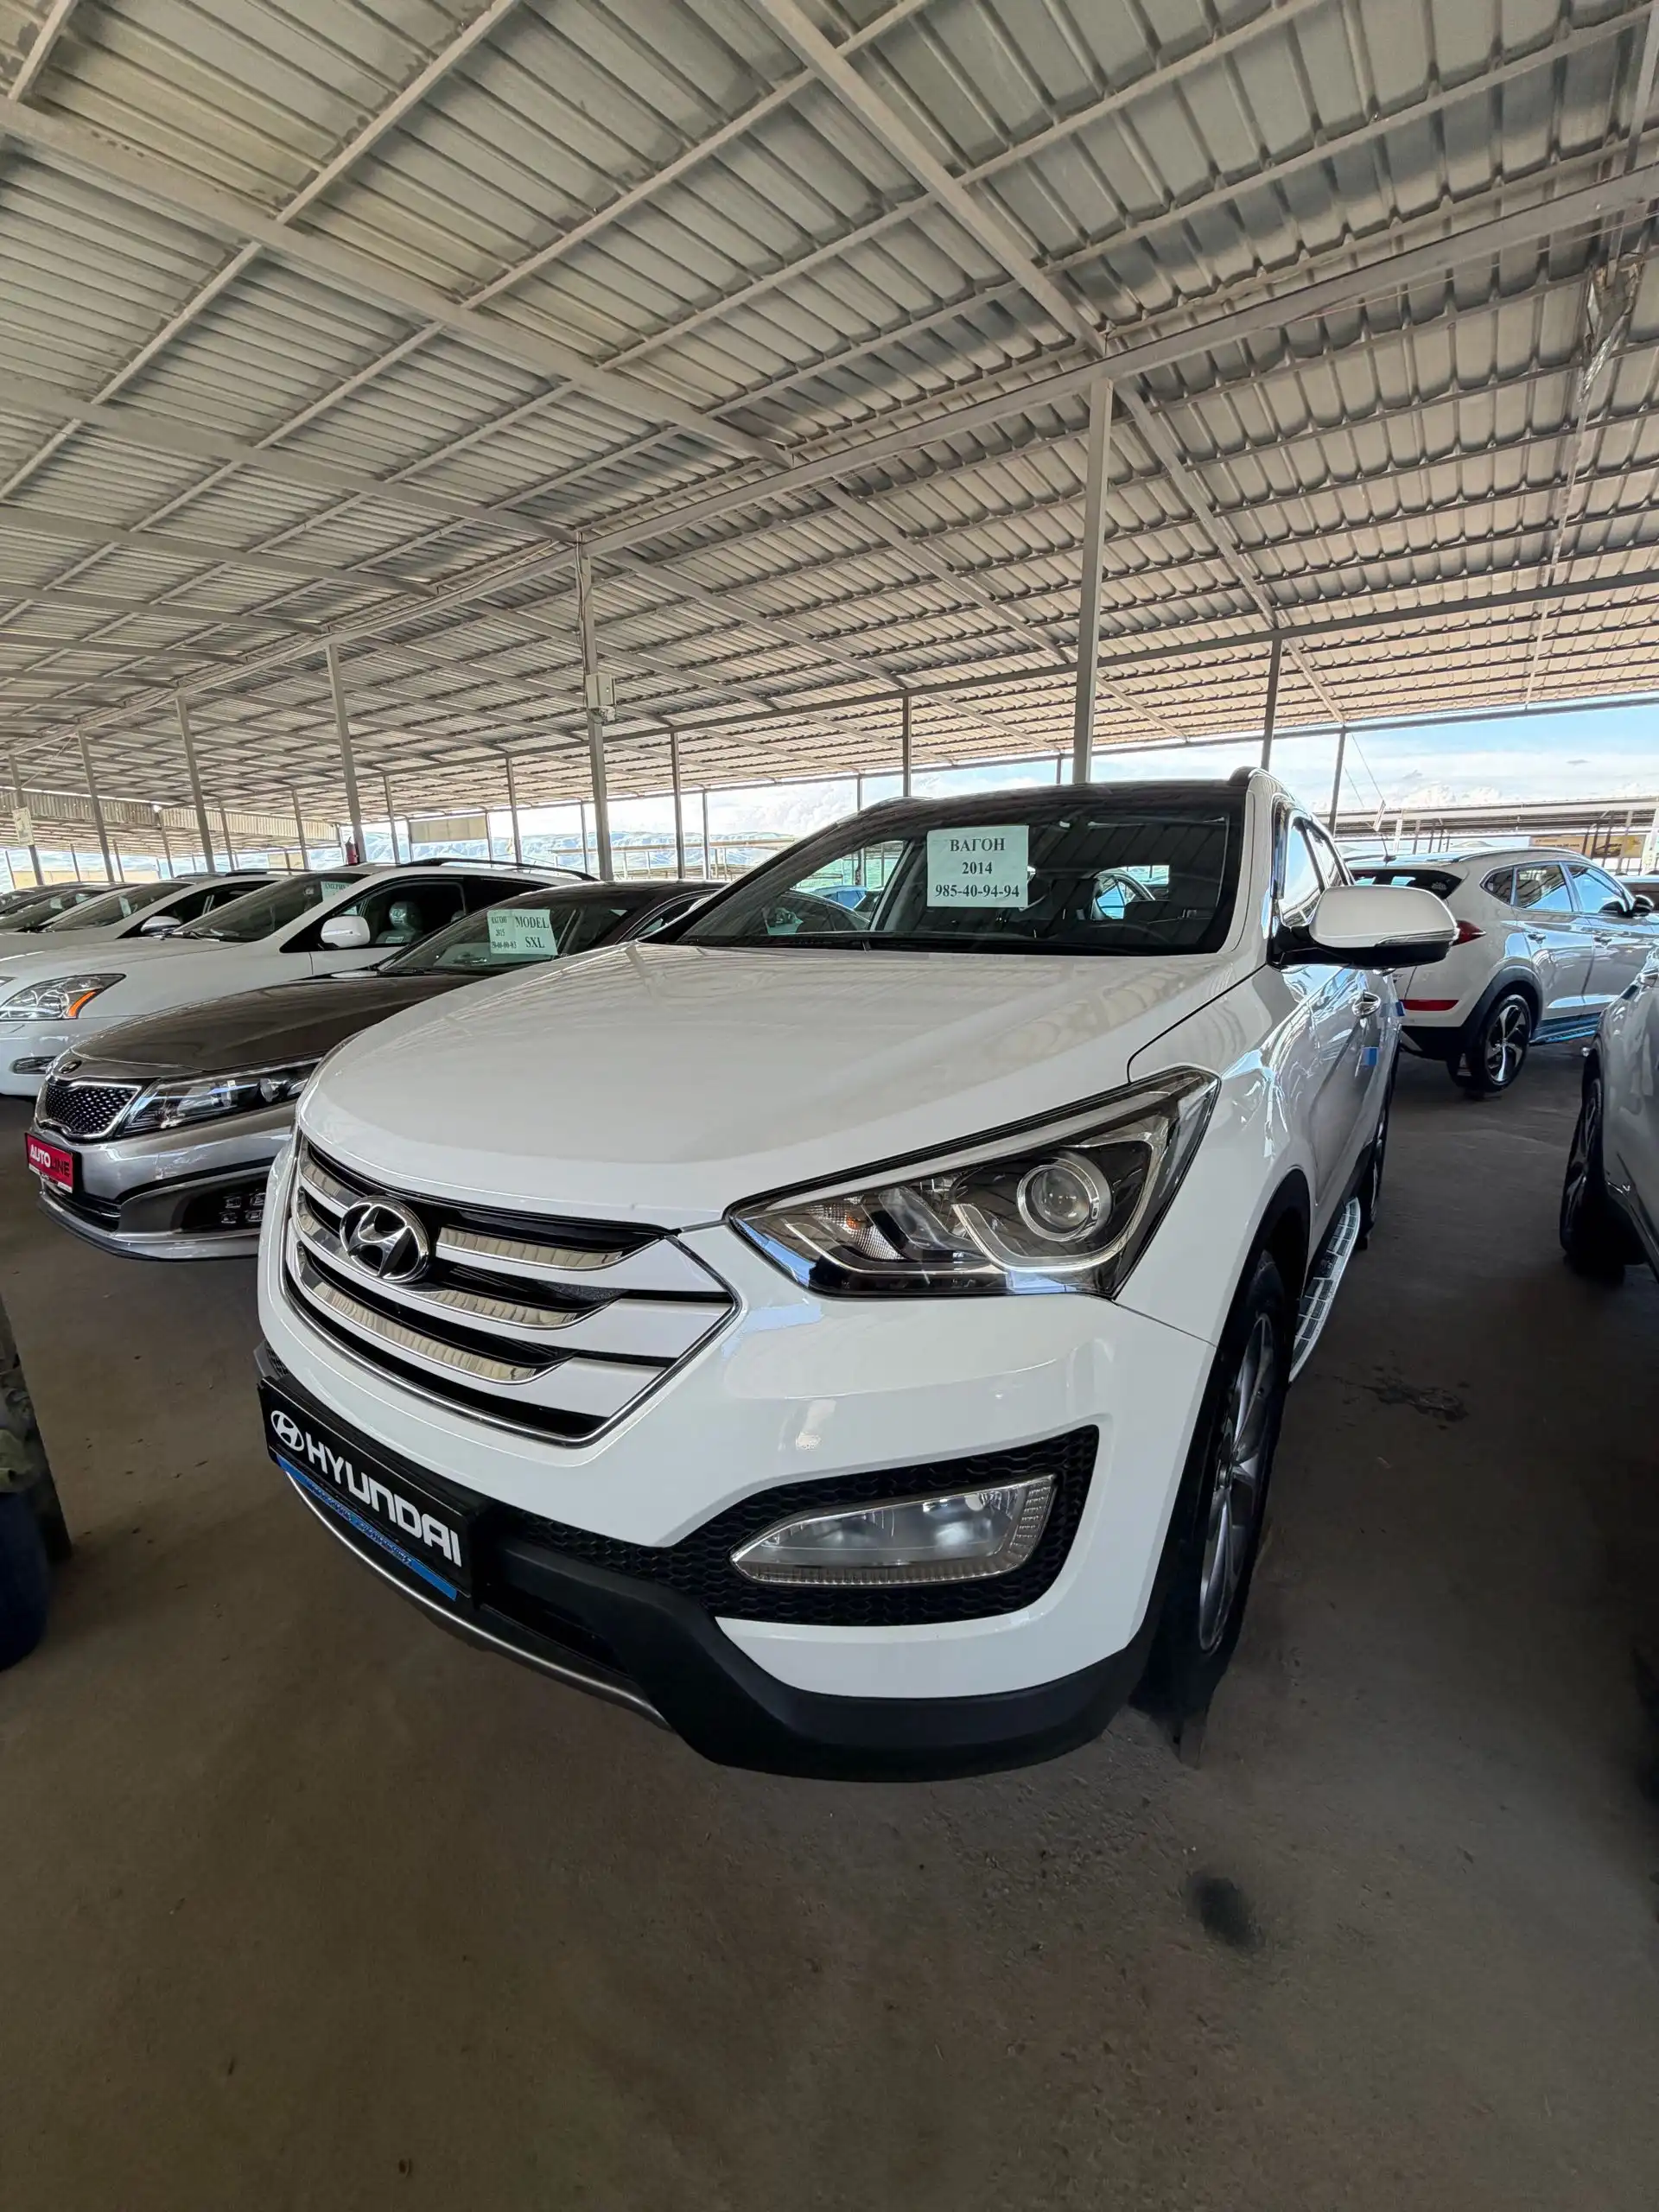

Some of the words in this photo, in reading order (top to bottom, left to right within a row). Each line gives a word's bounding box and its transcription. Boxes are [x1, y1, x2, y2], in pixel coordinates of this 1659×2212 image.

[950, 837, 1006, 852] ВАГОН
[962, 861, 993, 874] 2014
[935, 884, 1020, 898] 985-40-94-94
[515, 916, 550, 929] MODEL
[524, 936, 545, 949] SXL
[305, 1431, 462, 1567] HYUNDAI
